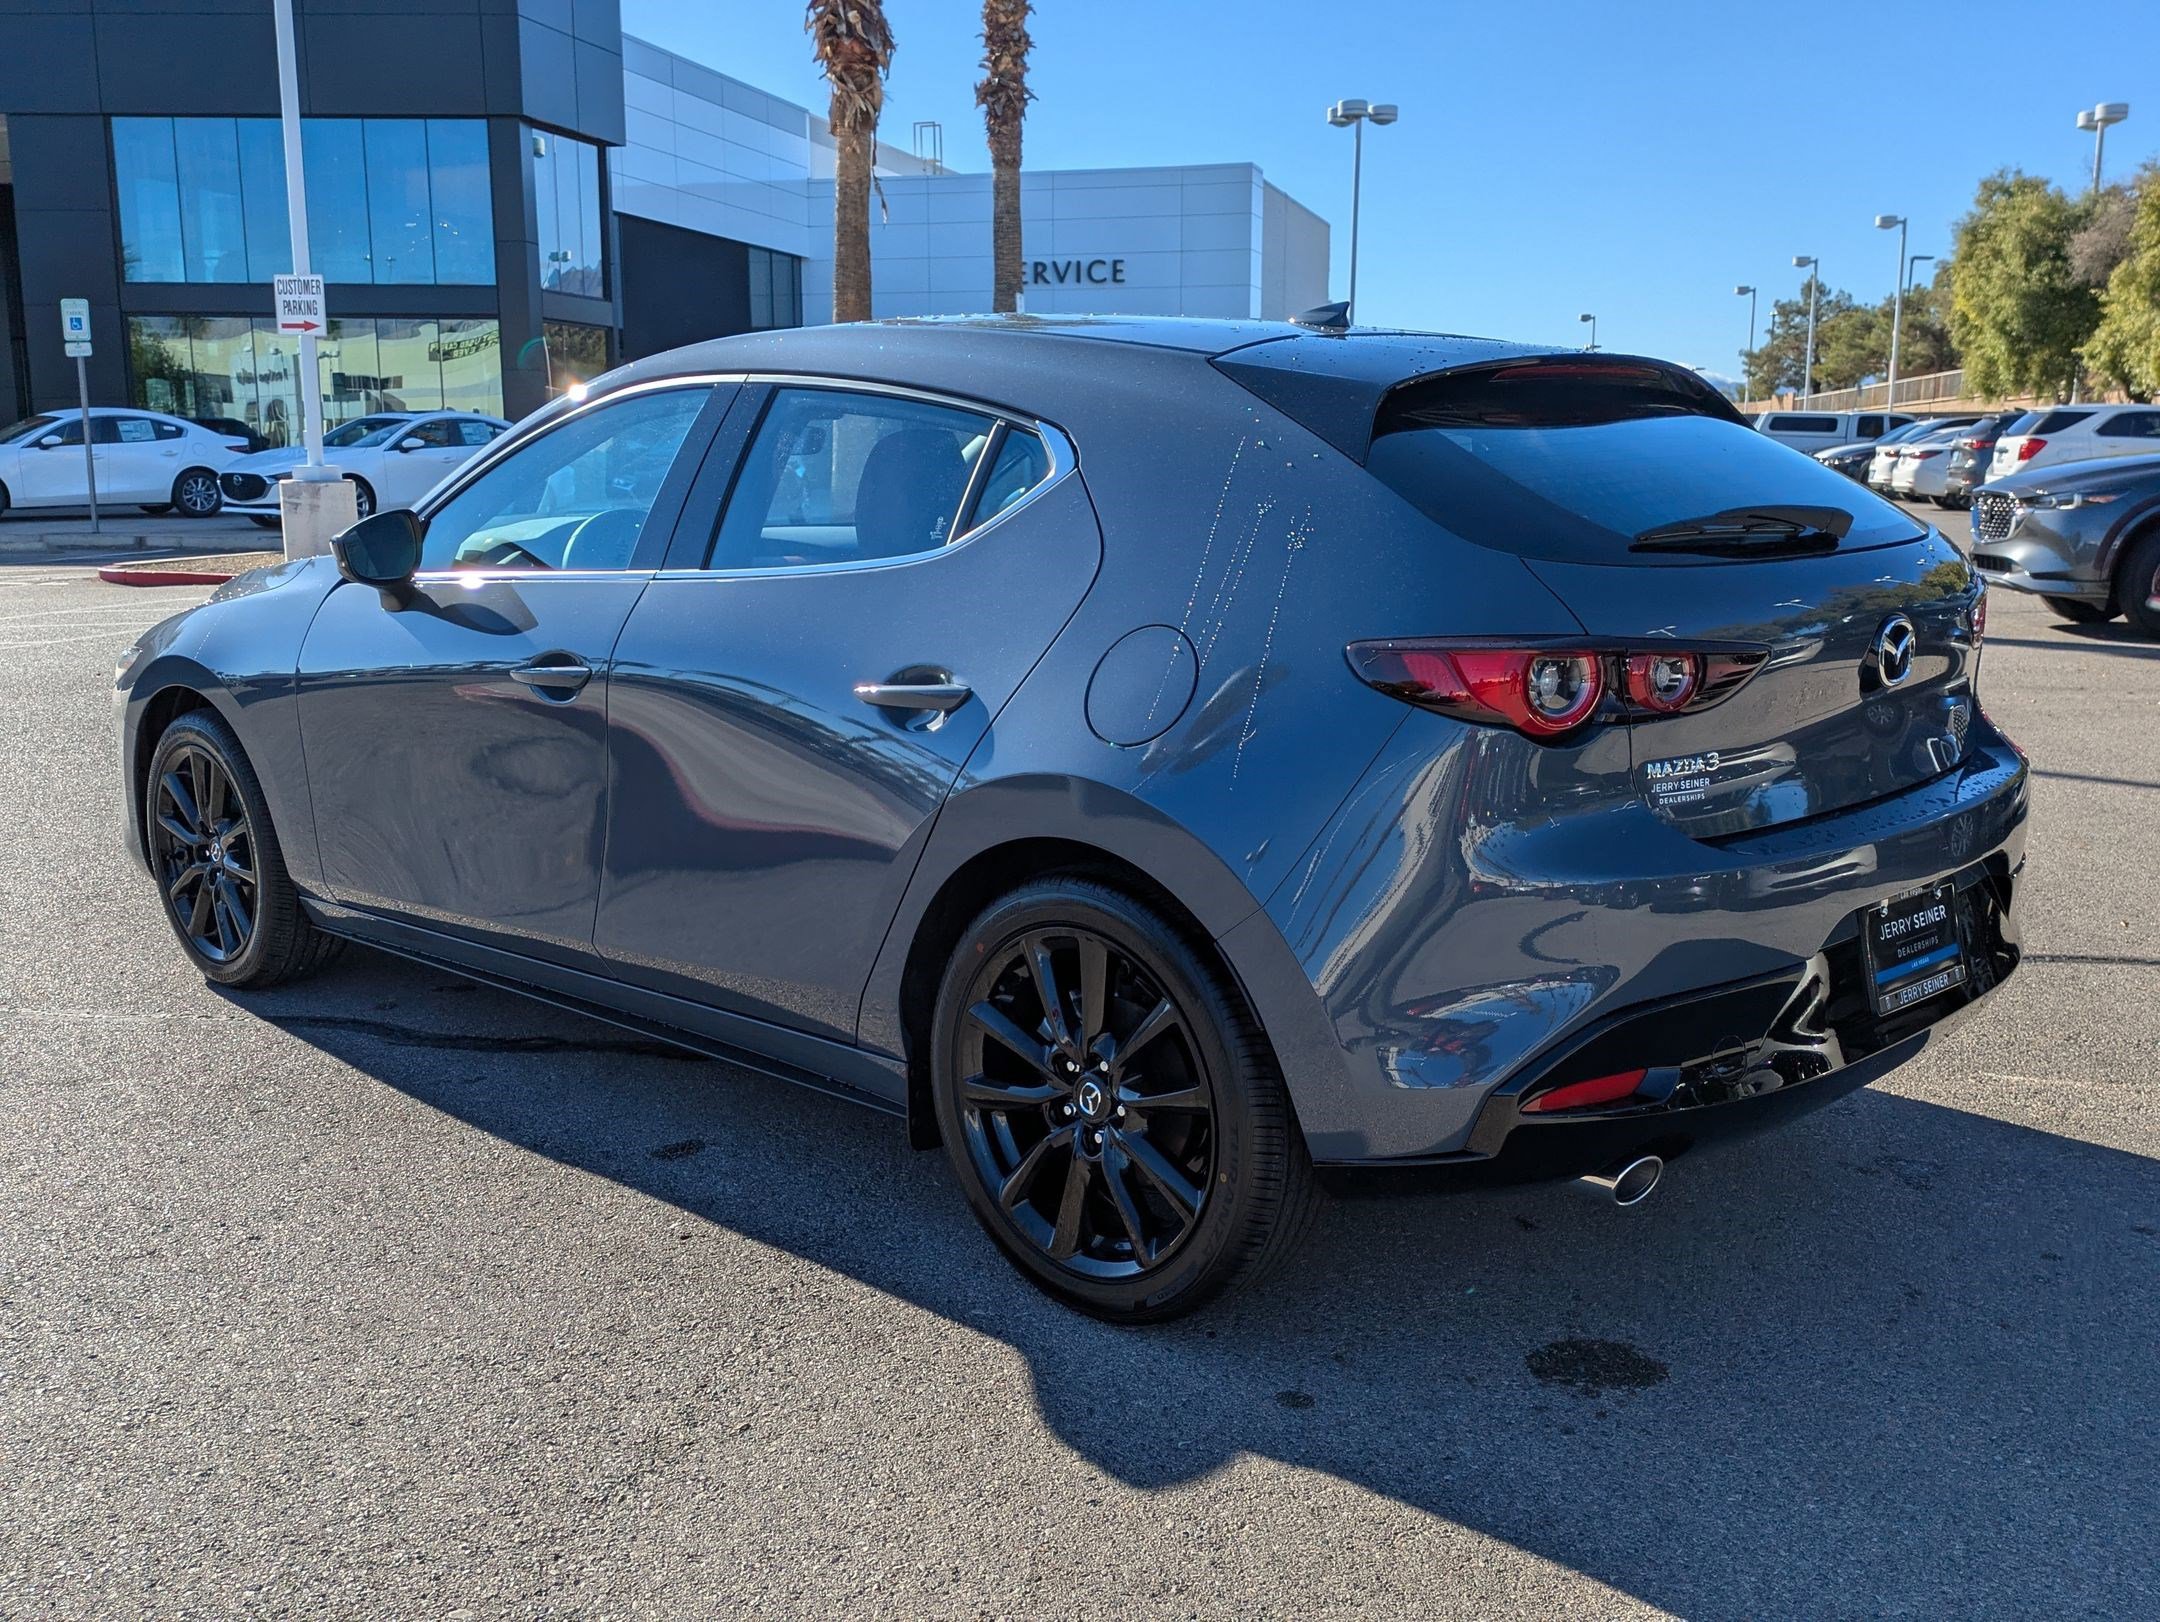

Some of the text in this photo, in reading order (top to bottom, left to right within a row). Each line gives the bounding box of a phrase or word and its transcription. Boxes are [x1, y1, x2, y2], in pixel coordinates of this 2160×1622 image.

[1021, 259, 1125, 284] ERVICE
[277, 279, 321, 295] CUSTOMER
[283, 300, 318, 316] PARKING
[1651, 778, 1710, 793] JERRY SEINER
[1659, 793, 1705, 805] DEALERSHIPS
[1880, 904, 1947, 940] JERRY SEINER
[1897, 935, 1939, 958] DEALERSHIPS
[1899, 974, 1949, 1005] JERRY SEINER
